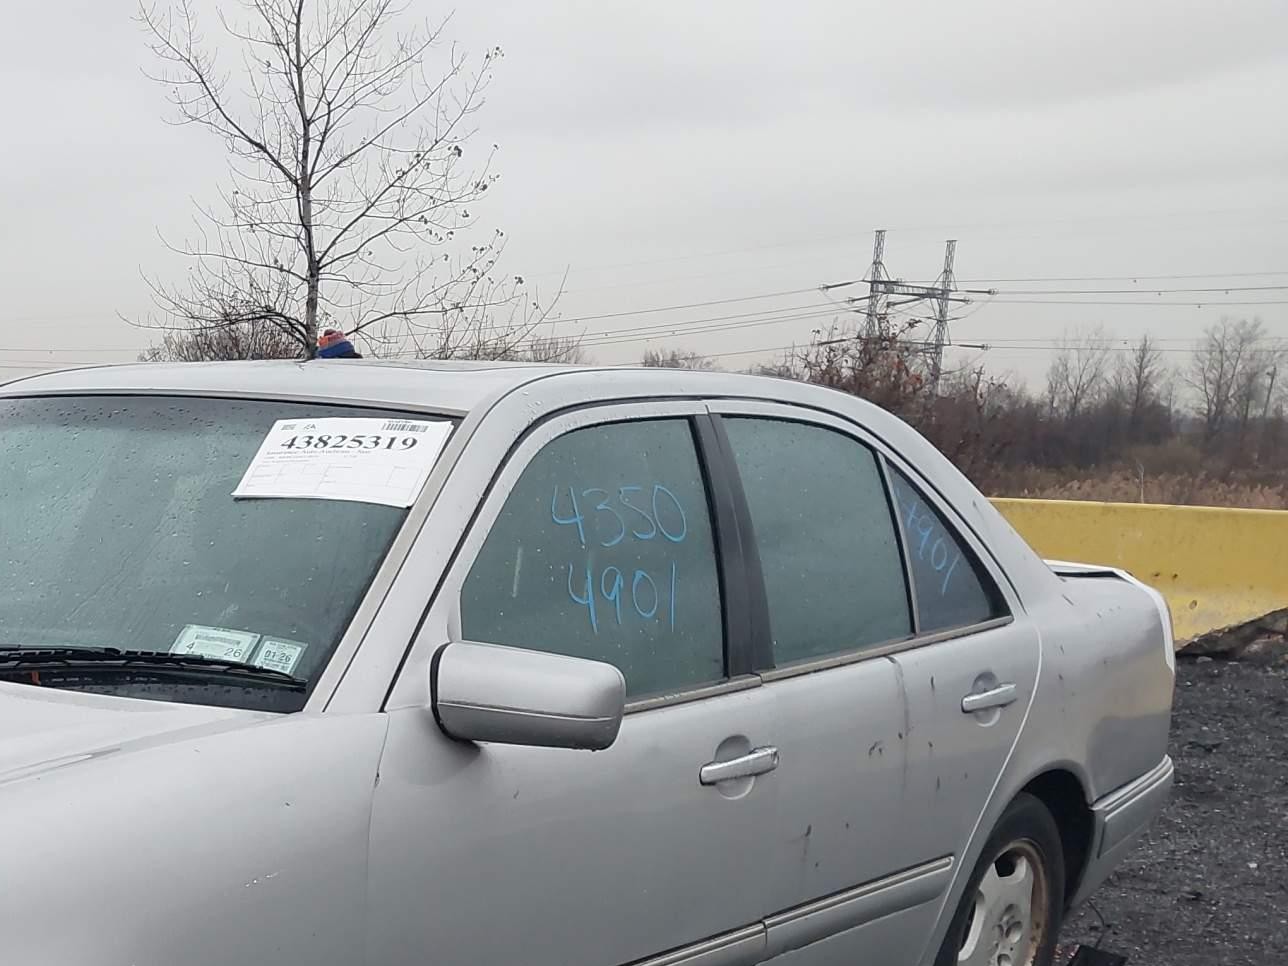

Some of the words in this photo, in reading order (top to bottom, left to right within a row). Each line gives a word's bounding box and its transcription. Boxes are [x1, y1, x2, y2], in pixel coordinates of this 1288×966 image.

[280, 434, 418, 451] 43825319
[550, 484, 688, 547] 4350
[567, 559, 677, 634] 4901
[223, 647, 244, 659] 26
